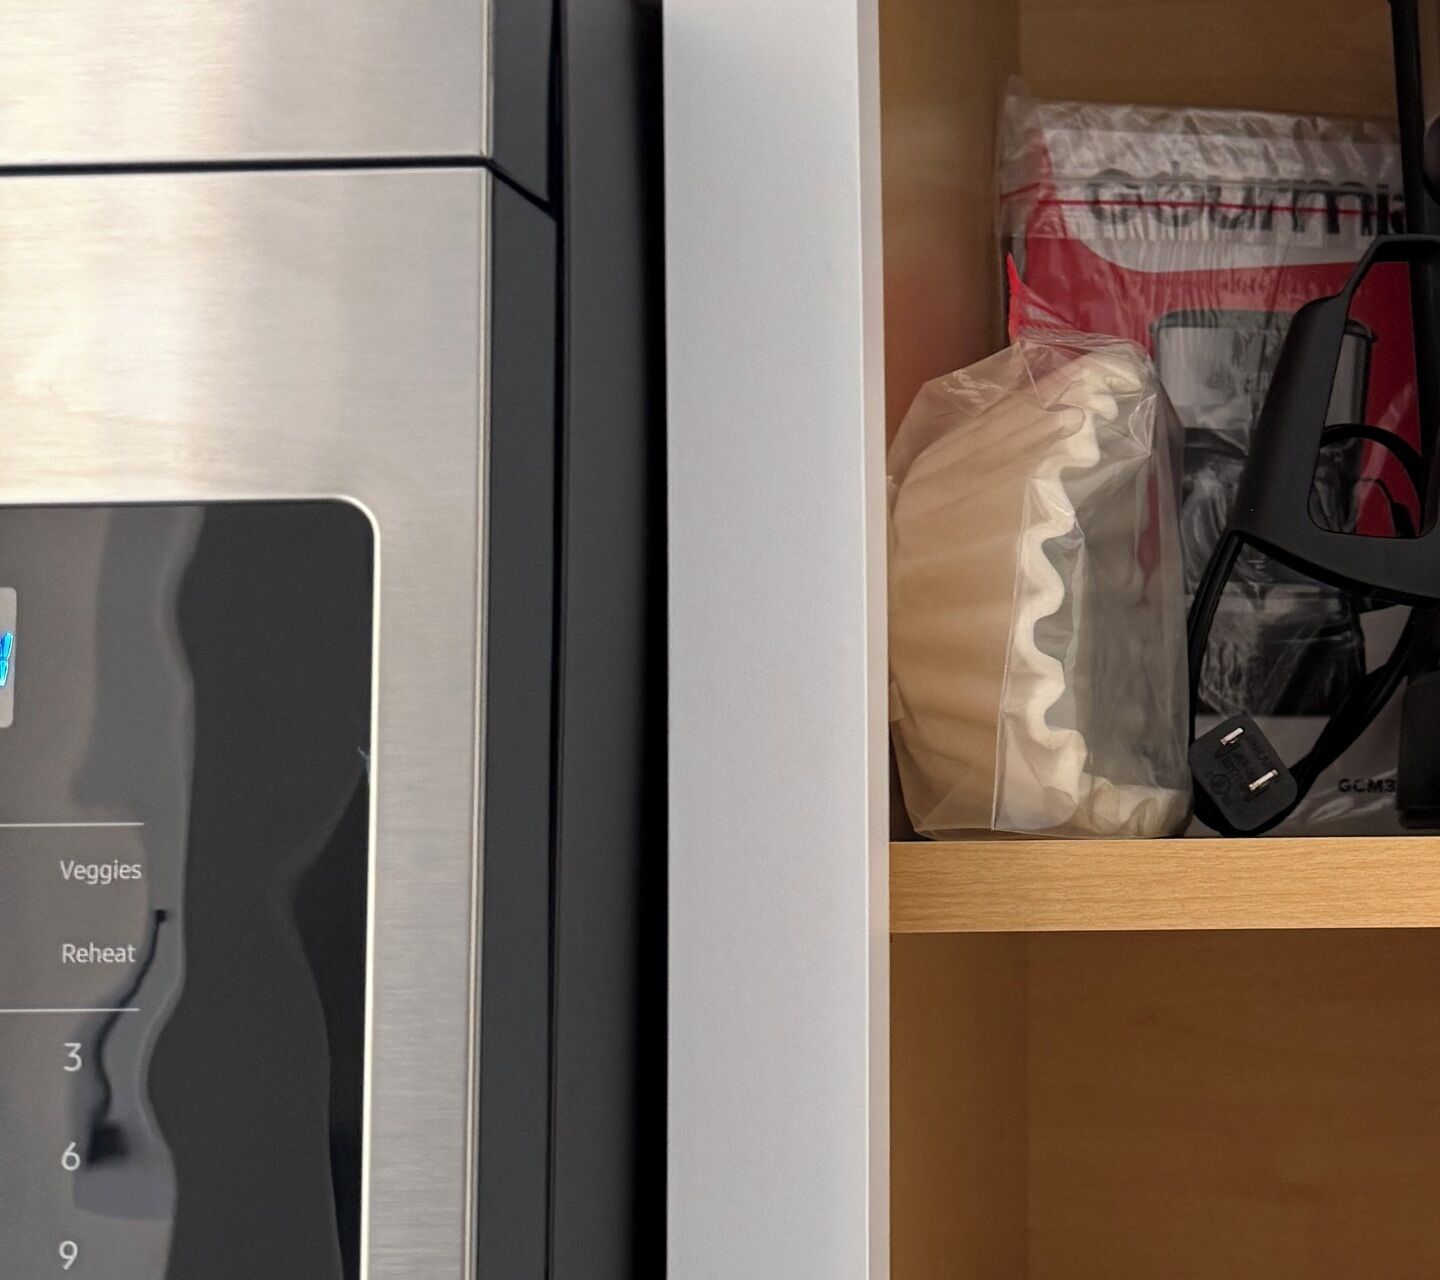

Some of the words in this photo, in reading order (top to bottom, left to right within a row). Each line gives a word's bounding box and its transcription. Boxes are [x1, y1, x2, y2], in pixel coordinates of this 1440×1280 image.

[59, 859, 142, 885] Veggies
[62, 942, 136, 963] Reheat
[63, 1042, 82, 1072] 3
[61, 1141, 81, 1171] 6
[58, 1240, 78, 1270] 9
